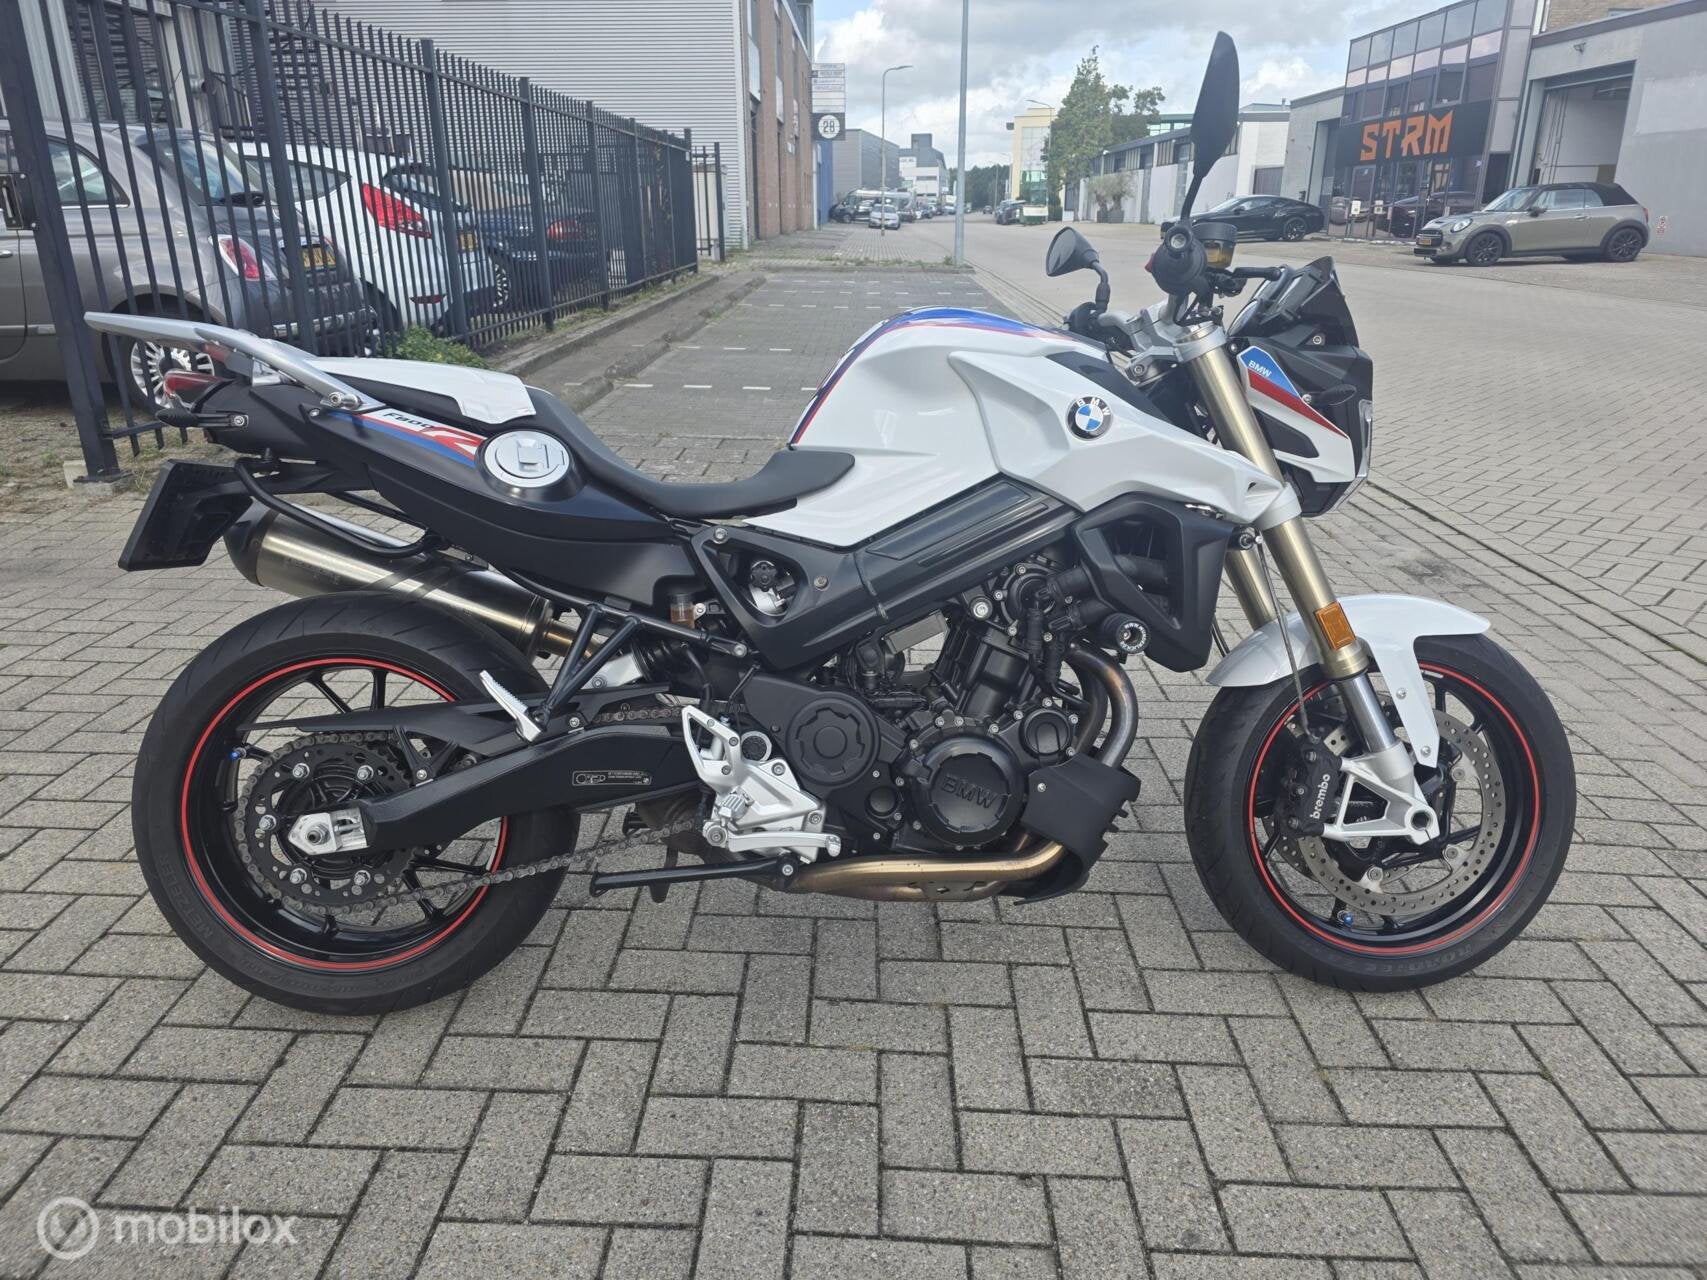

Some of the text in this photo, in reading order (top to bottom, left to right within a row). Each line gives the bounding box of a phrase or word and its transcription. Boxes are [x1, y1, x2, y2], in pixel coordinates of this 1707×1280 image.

[1360, 109, 1453, 160] STRM
[1248, 360, 1272, 378] BMW
[1076, 397, 1111, 416] BMW
[941, 773, 999, 809] BMW
[1310, 773, 1331, 820] brembo
